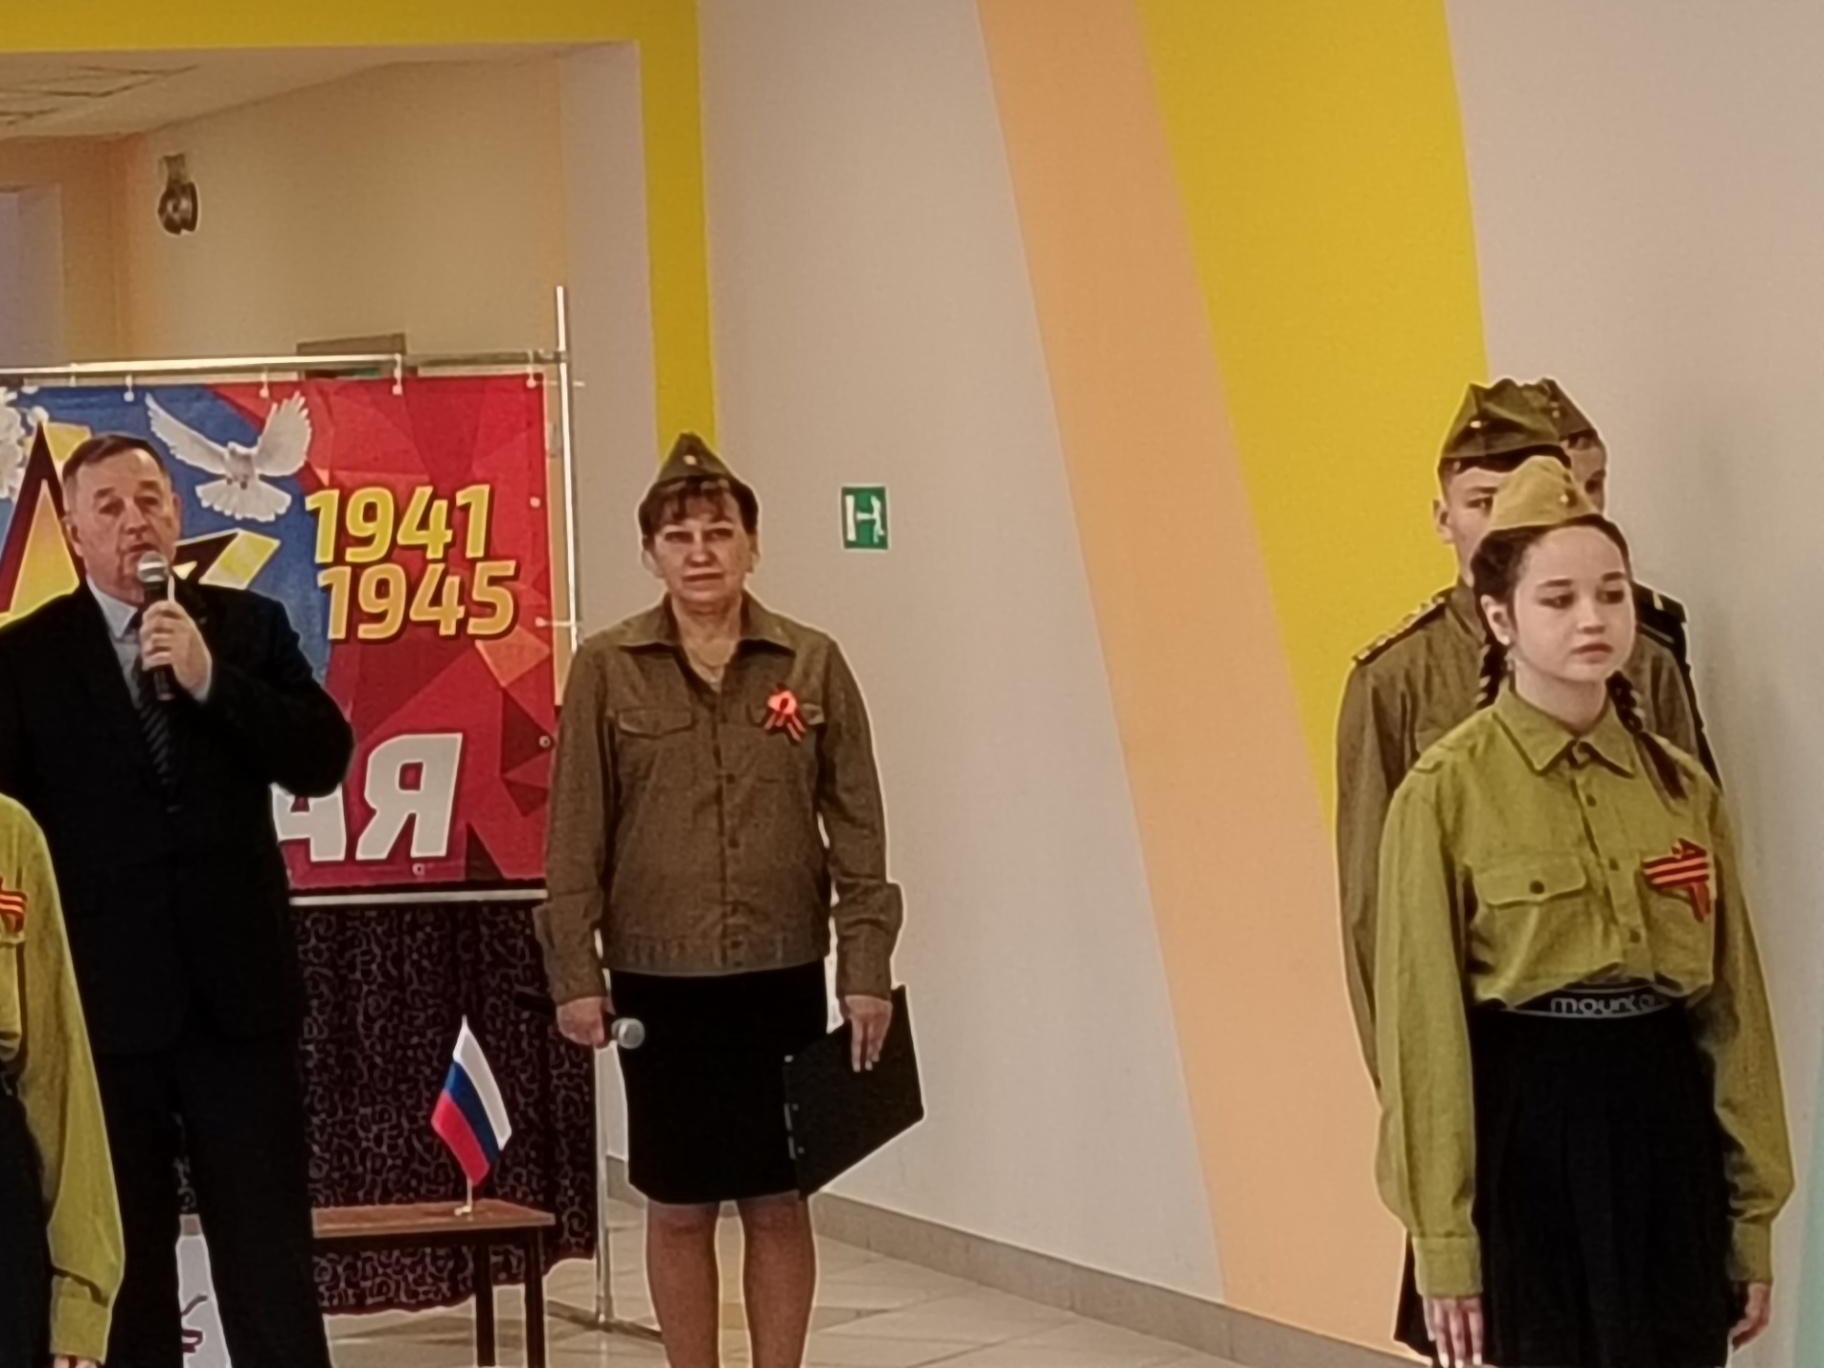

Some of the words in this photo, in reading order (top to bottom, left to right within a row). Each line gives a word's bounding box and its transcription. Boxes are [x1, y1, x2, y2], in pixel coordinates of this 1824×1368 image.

[305, 484, 491, 564] 1941
[317, 559, 517, 640] 1945
[270, 732, 464, 863] АЯ
